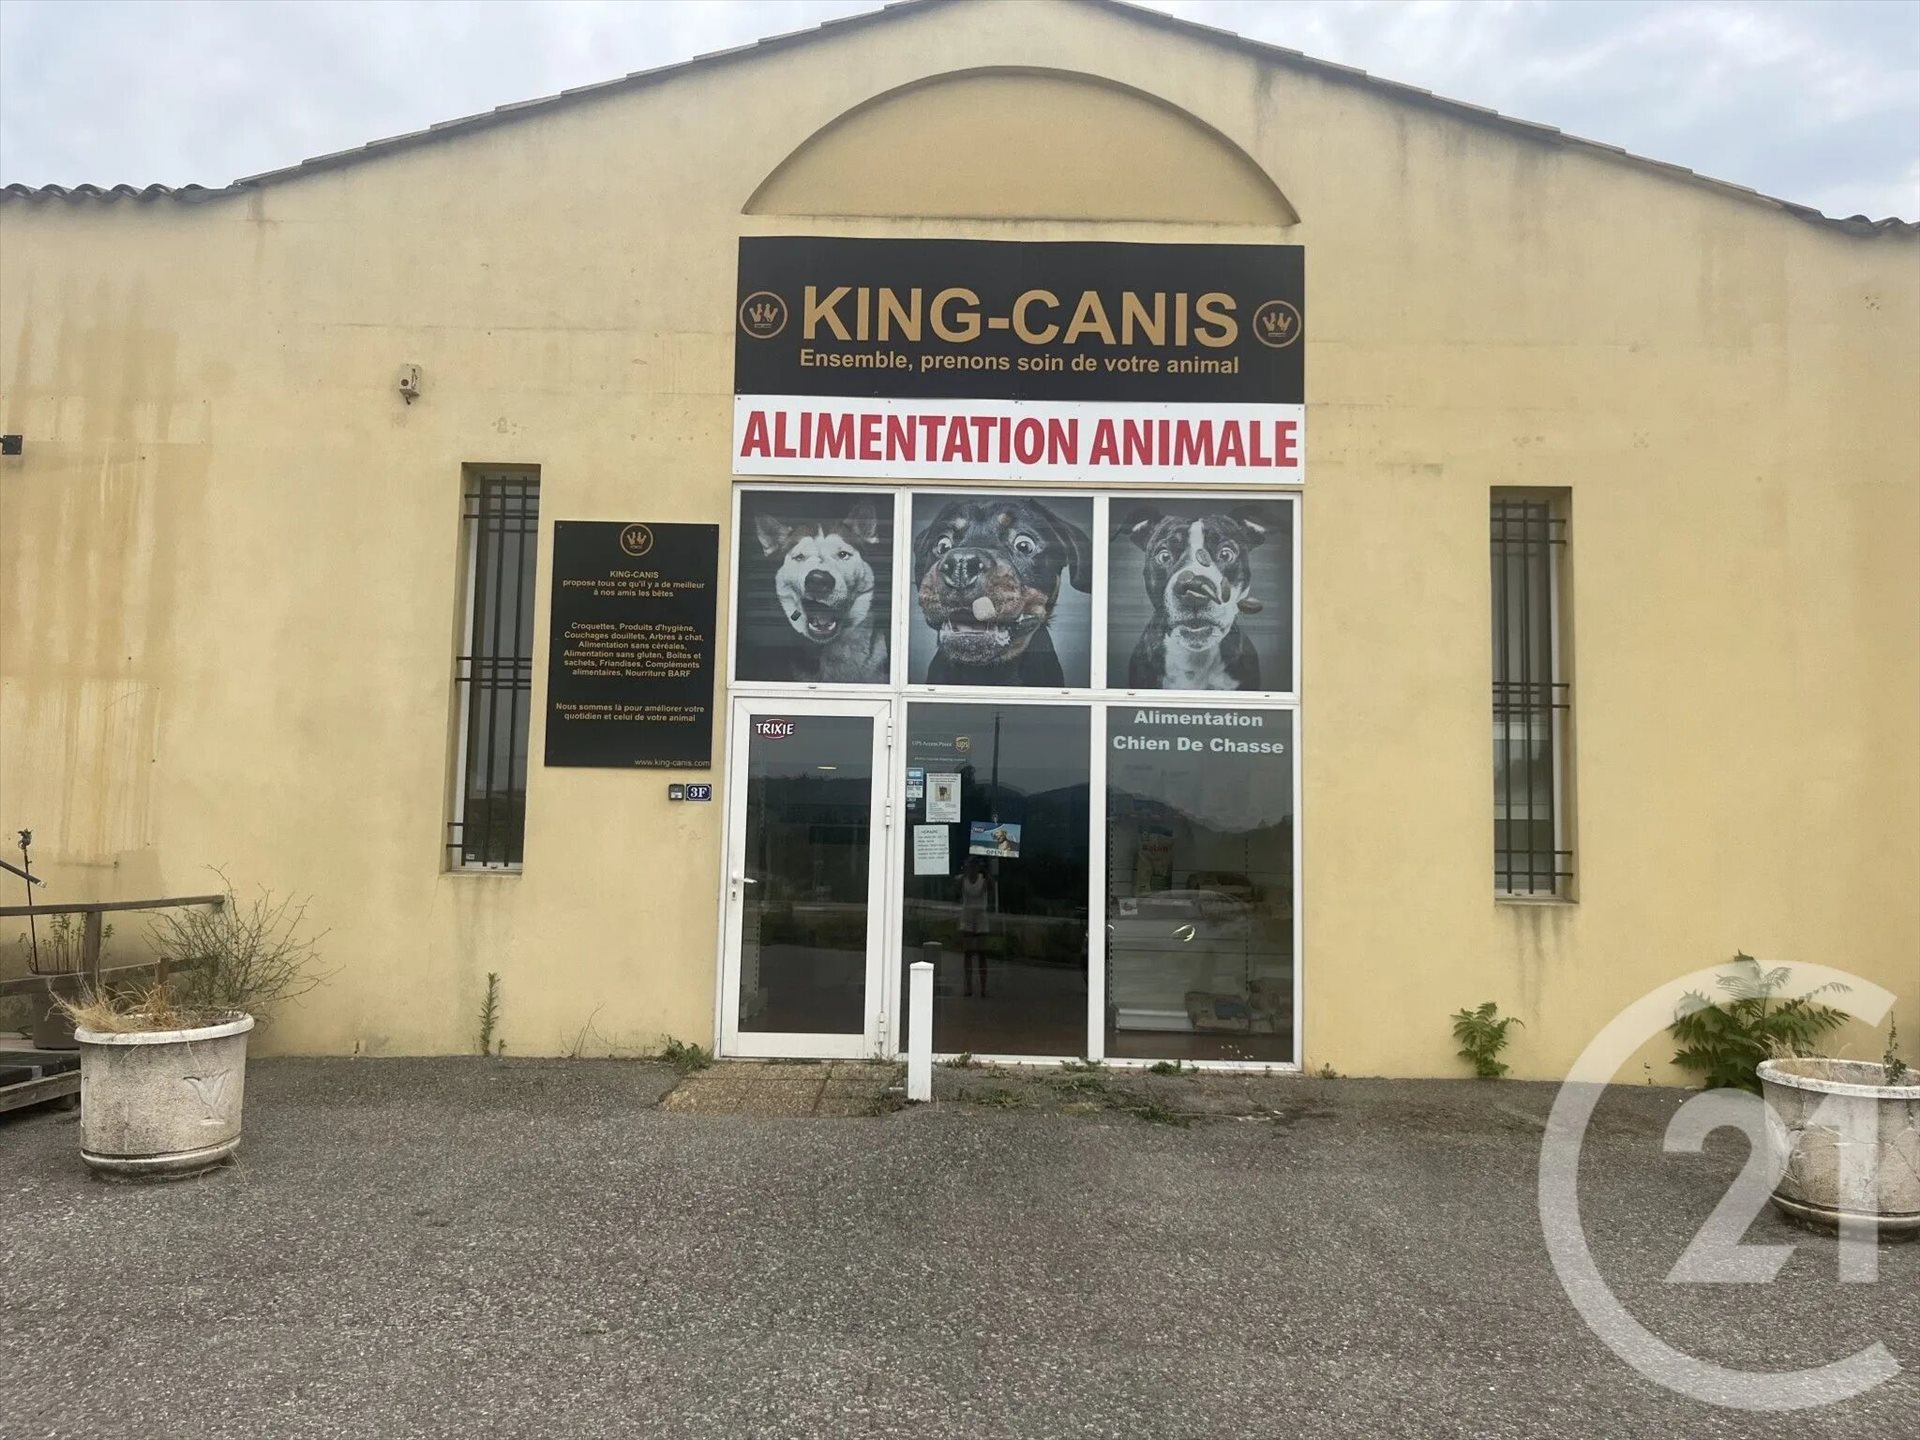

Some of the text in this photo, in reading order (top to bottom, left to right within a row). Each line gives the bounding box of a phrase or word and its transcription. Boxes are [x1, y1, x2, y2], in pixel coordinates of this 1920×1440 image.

[802, 285, 1239, 348] KING-CANIS
[800, 348, 1239, 375] Ensemble, prenons soin de votre animal
[740, 410, 1298, 468] ALIMENTATION ANIMALE
[610, 571, 659, 579] KING-CANIS
[563, 579, 596, 588] propose
[629, 581, 646, 589] qu'il
[673, 581, 705, 589] meilleur
[571, 622, 617, 631] Croquettes,
[619, 623, 653, 631] Produits
[564, 631, 609, 640] Couchages
[611, 632, 648, 640] douillets,
[649, 633, 676, 641] Arbres
[684, 634, 704, 642] chat,
[578, 641, 628, 649] Alimentation
[563, 650, 614, 658] Alimentation
[637, 651, 664, 660] gluten,
[564, 659, 597, 667] sachets,
[599, 660, 643, 668] Friandises,
[572, 669, 624, 677] alimentaires,
[625, 669, 666, 677] Nourriture
[556, 702, 577, 710] Nous
[615, 703, 622, 711] là
[624, 705, 643, 713] pour
[644, 705, 682, 713] améliorer
[564, 713, 602, 721] quotidien
[613, 713, 633, 721] celui
[669, 714, 696, 722] animal
[1134, 710, 1263, 727] Alimentation
[756, 723, 794, 735] TRIXIE
[1113, 736, 1284, 754] Chien De Chasse
[634, 758, 710, 768] www.king-canis.com
[690, 787, 707, 798] 3F
